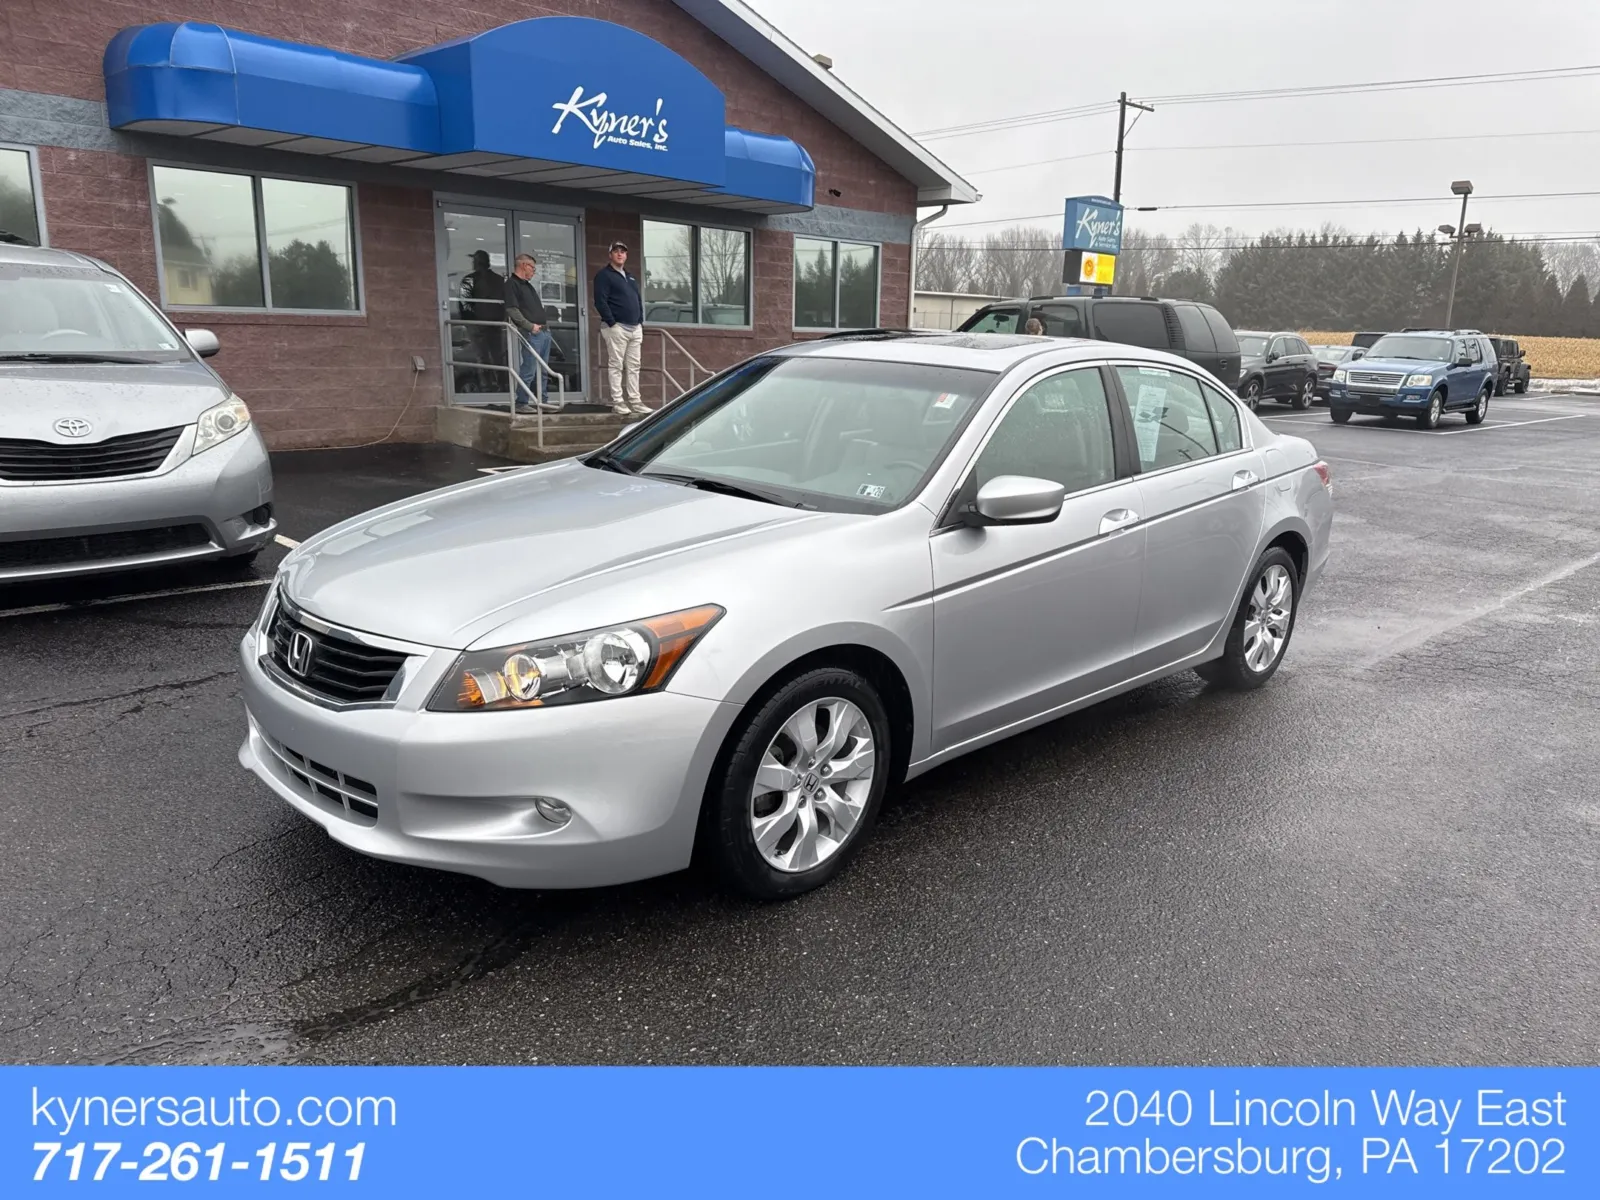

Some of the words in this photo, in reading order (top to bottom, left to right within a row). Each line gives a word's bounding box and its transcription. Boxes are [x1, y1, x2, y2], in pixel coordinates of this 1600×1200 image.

[551, 85, 668, 149] Kyner's
[607, 135, 628, 145] Auto
[628, 138, 653, 150] Sales,
[1075, 207, 1121, 249] Kyner's
